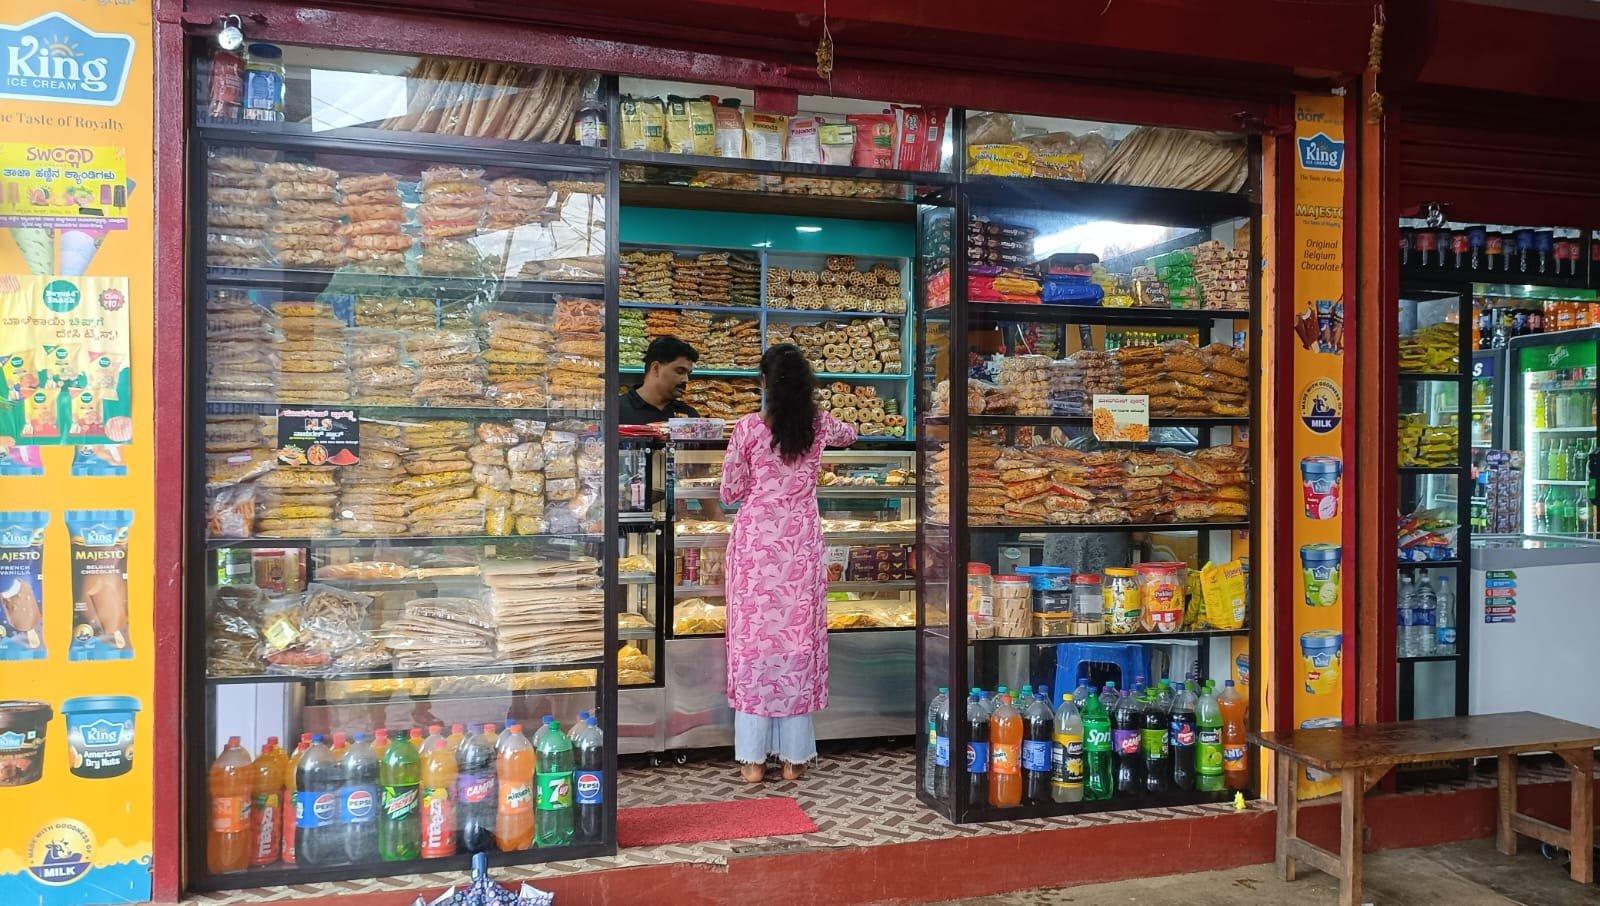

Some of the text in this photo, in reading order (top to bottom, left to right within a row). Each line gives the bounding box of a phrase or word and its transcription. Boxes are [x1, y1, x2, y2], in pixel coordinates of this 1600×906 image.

[8, 35, 109, 92] King
[7, 78, 77, 90] ICE CREAM
[16, 113, 53, 126] Taste
[57, 115, 72, 127] of
[75, 116, 124, 132] Royalty
[1306, 142, 1338, 166] King
[1306, 239, 1338, 250] Original
[1303, 250, 1336, 261] Belgium
[1311, 419, 1332, 428] MILK
[2, 531, 28, 544] King
[87, 530, 113, 543] King
[0, 551, 40, 561] AJESTO
[75, 550, 125, 560] MAJESTO
[87, 727, 118, 742] King
[83, 749, 122, 759] American
[85, 758, 121, 769] Dry Nuts
[428, 800, 443, 848] maaza
[35, 825, 54, 838] WITH
[55, 823, 90, 843] GOODNESS
[258, 806, 273, 857] maaza
[43, 866, 76, 878] MILK
